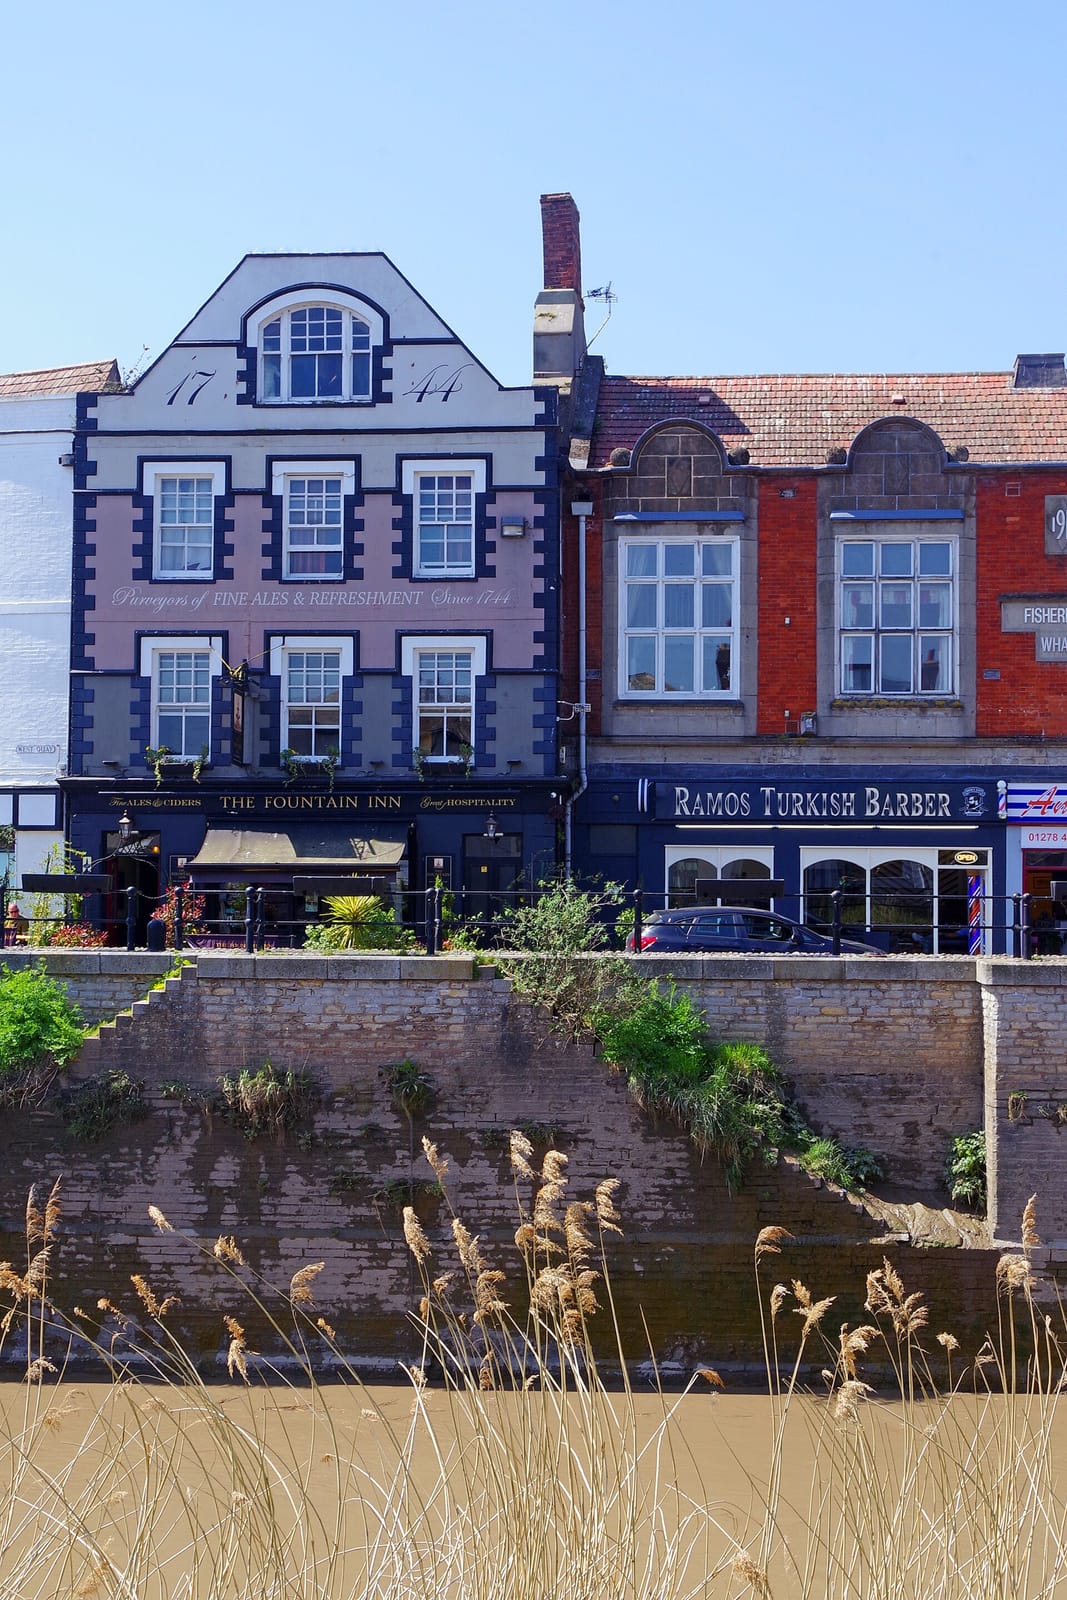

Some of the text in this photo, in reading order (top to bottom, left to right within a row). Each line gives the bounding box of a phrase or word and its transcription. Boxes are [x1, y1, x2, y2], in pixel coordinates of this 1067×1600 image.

[166, 363, 474, 405] 17 44
[1051, 509, 1067, 540] 19
[112, 586, 515, 614] Purveyors of FINE ALES & REFRESHMENT Since 1744
[1024, 607, 1067, 623] FISHER
[219, 796, 401, 809] THE FOUNTAIN INN
[1028, 832, 1058, 842] 01278
[956, 853, 977, 862] OPEN
